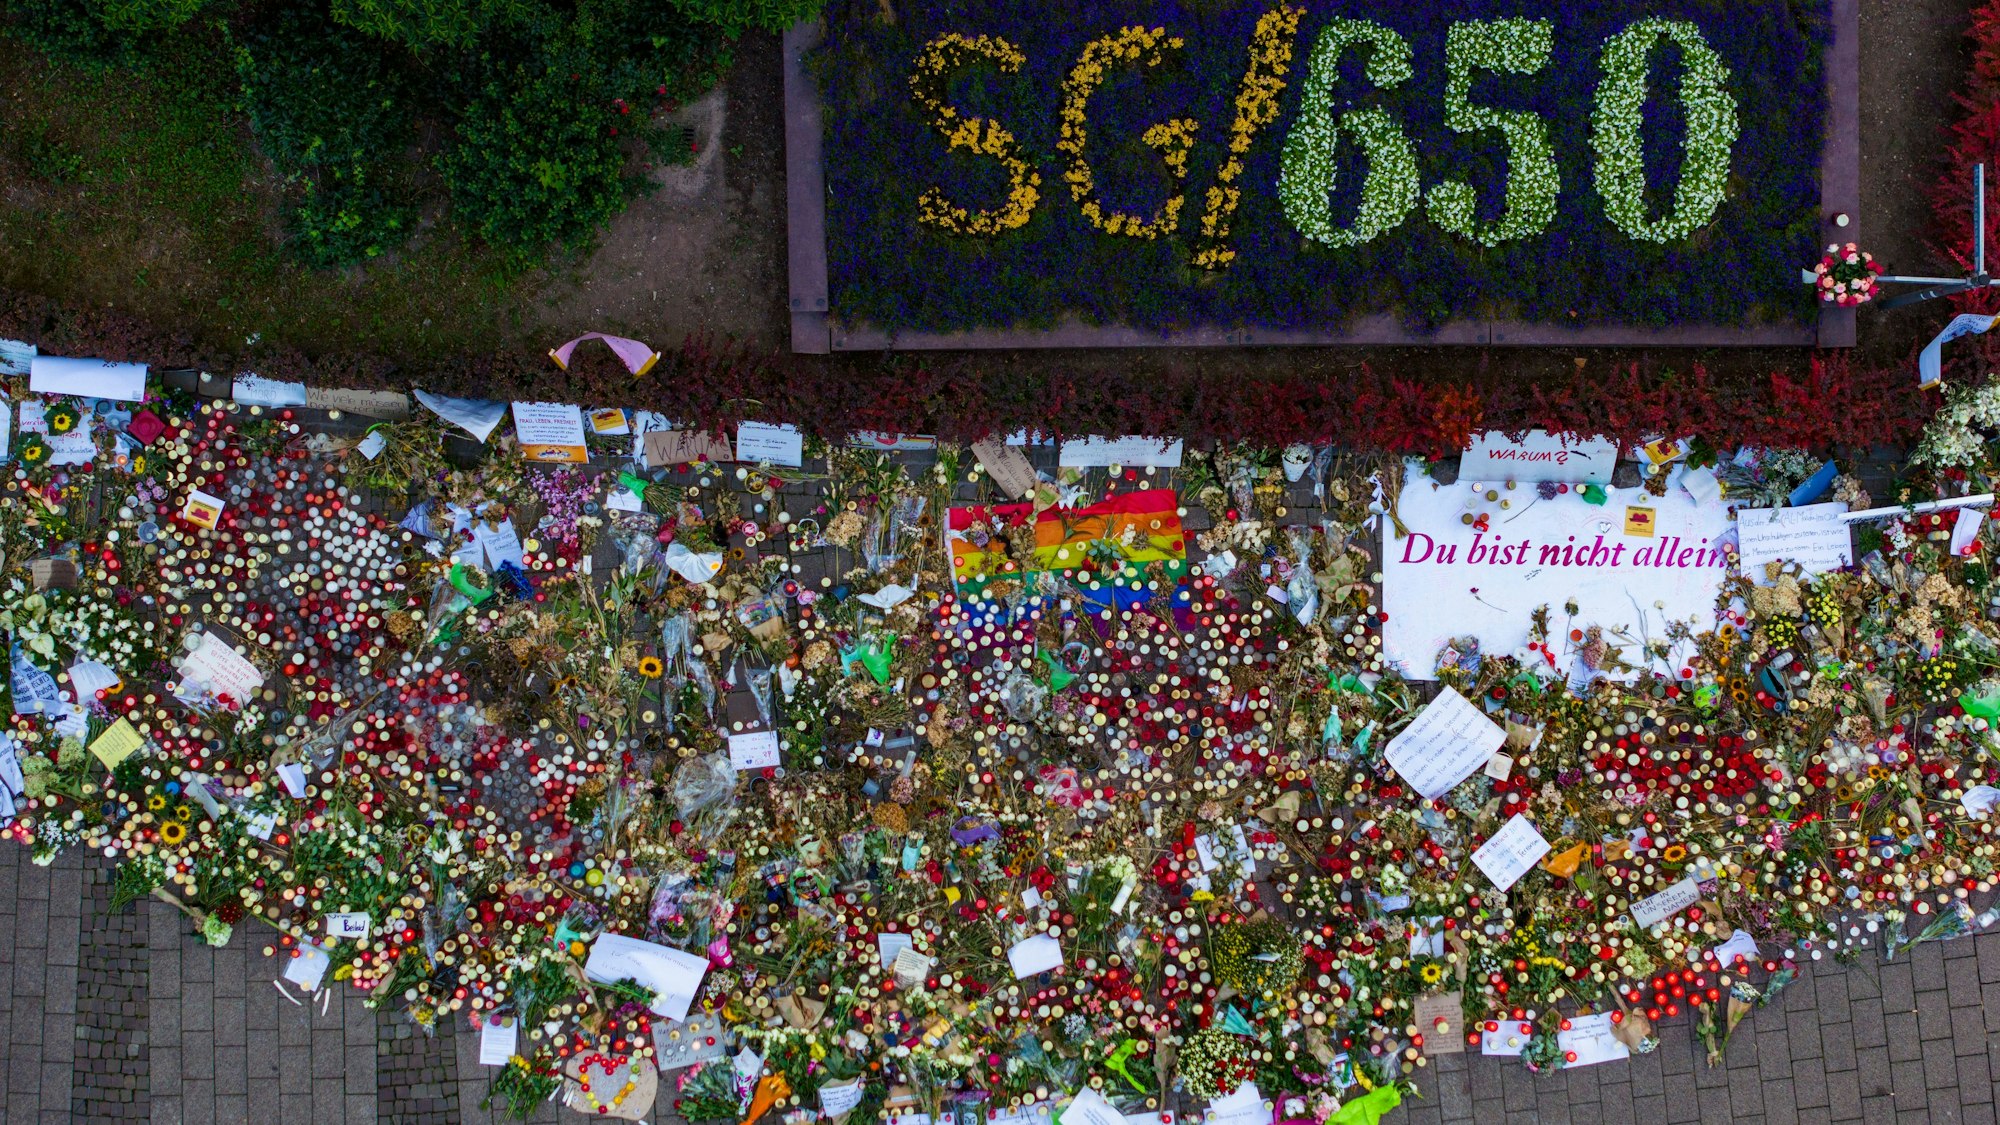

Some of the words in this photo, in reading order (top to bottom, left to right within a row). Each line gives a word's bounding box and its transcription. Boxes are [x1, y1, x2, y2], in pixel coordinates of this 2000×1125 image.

[1488, 448, 1569, 464] WARUM?
[1400, 532, 1457, 564] Du
[1467, 533, 1532, 565] bist
[1539, 535, 1627, 567] nicht
[1642, 857, 1686, 881] UNSEREM
[1662, 892, 1696, 913] NAMEN
